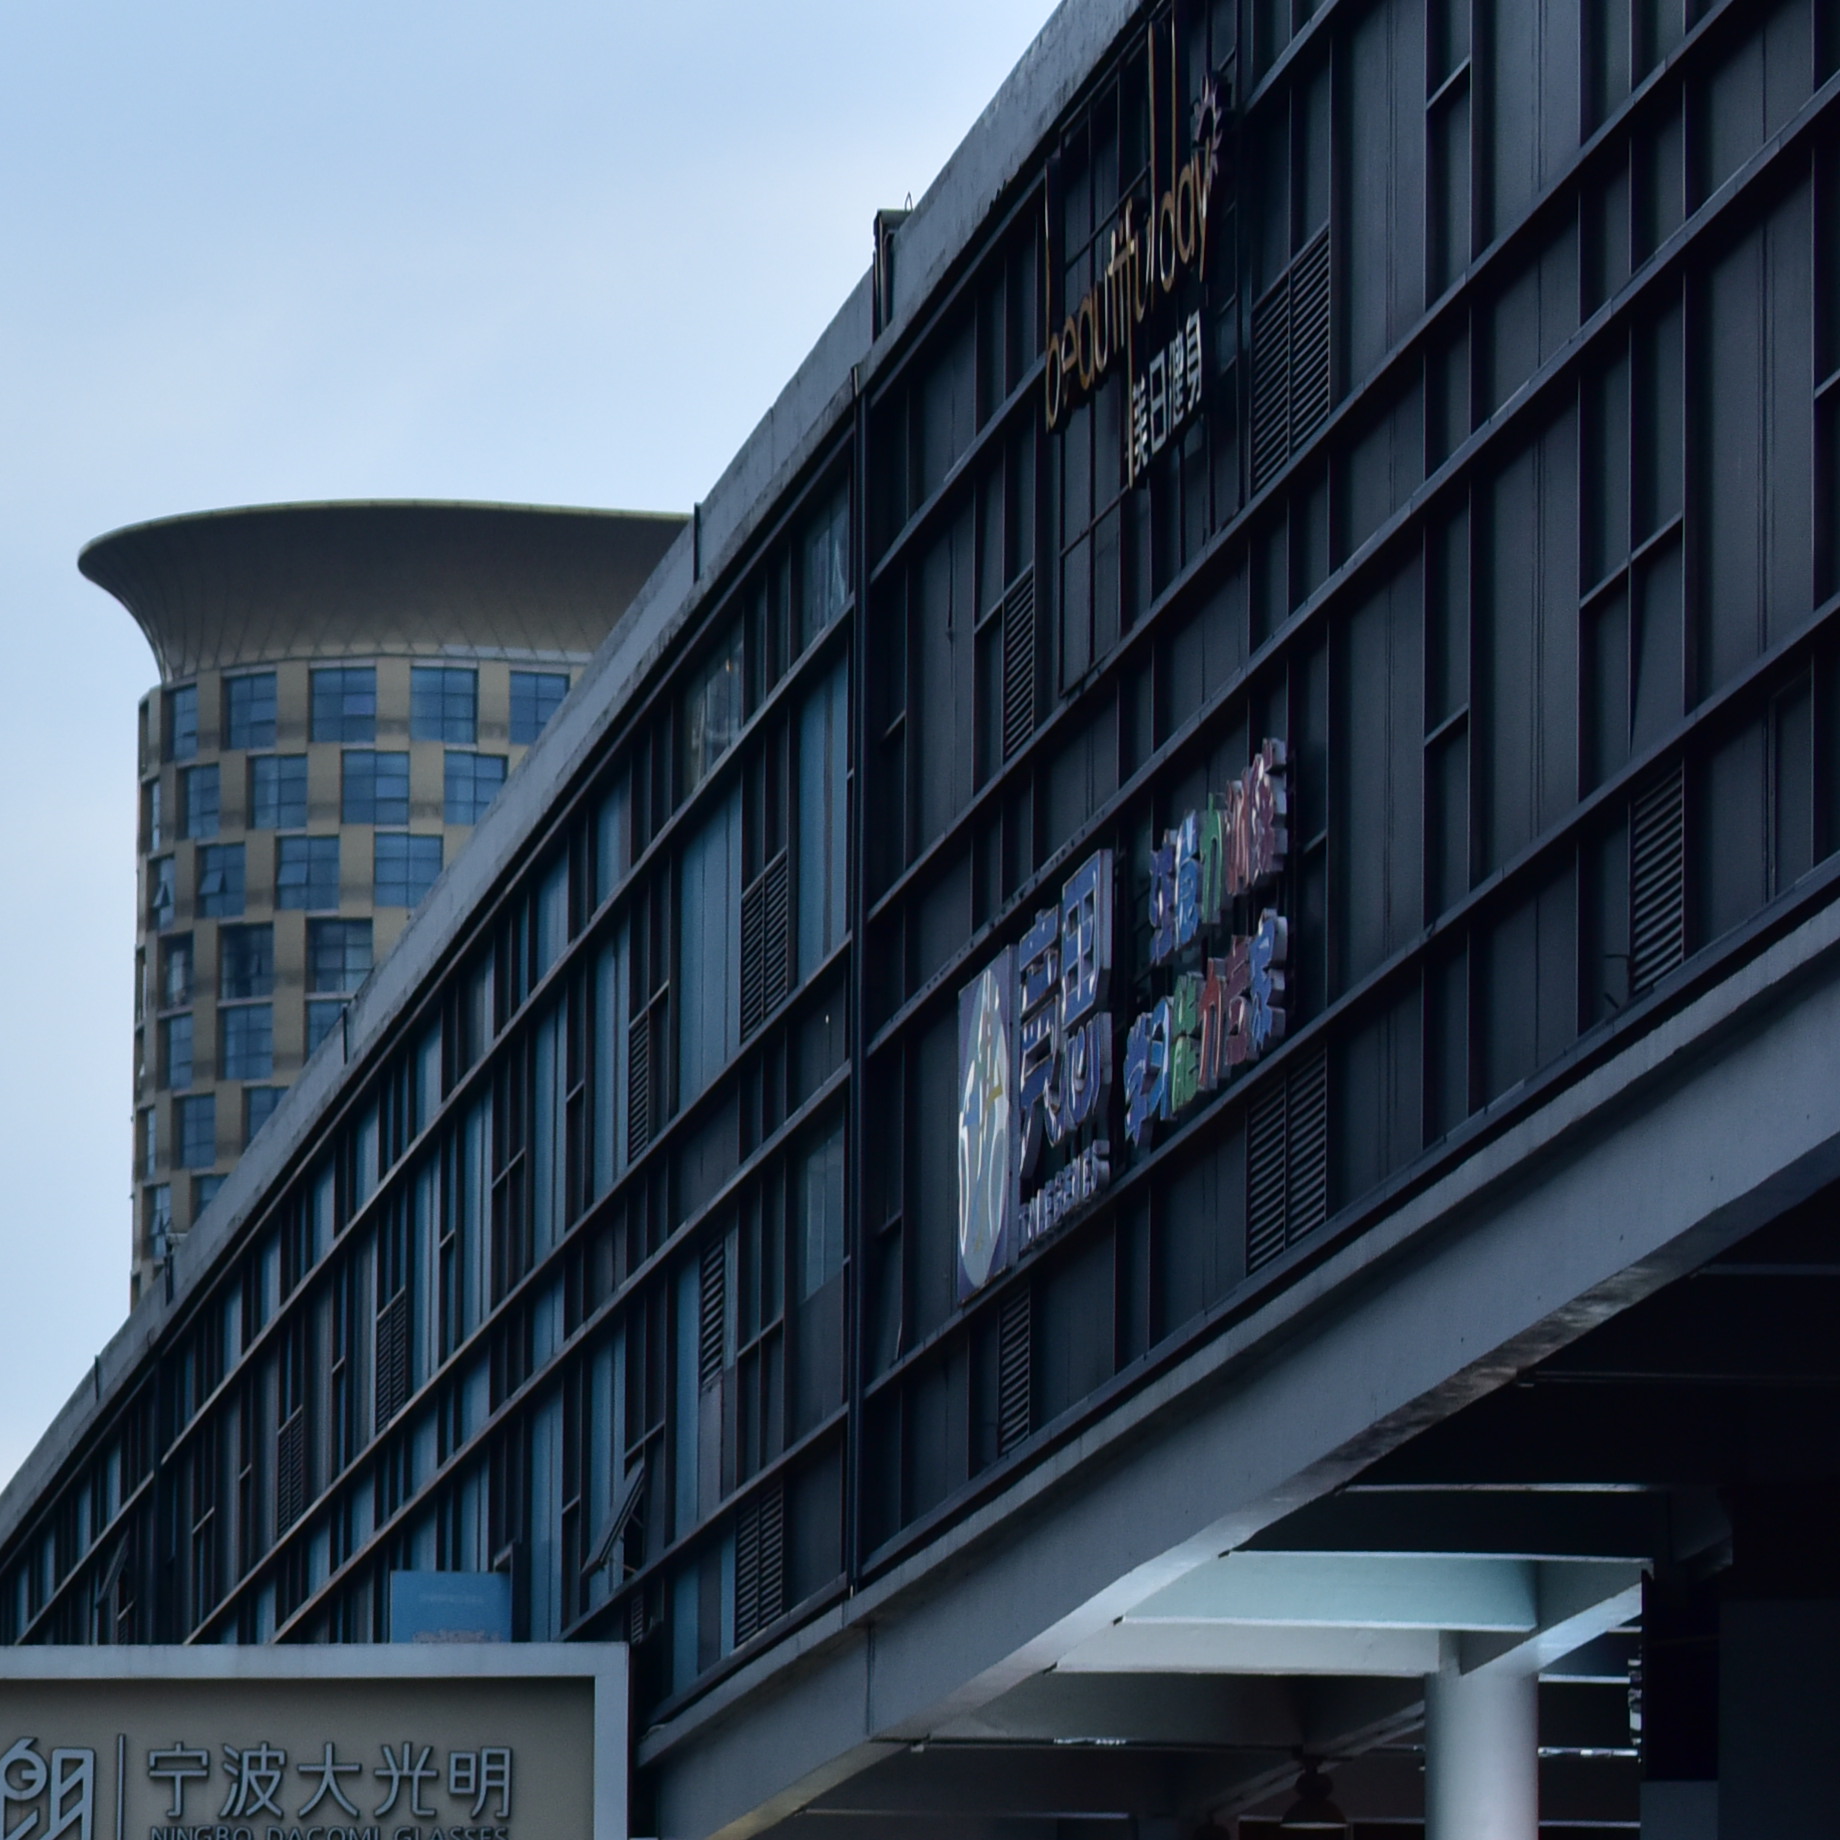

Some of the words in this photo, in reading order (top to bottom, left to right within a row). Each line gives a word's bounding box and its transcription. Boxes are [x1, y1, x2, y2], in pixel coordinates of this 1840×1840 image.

[148, 1742, 511, 1818] 宁波大光明
